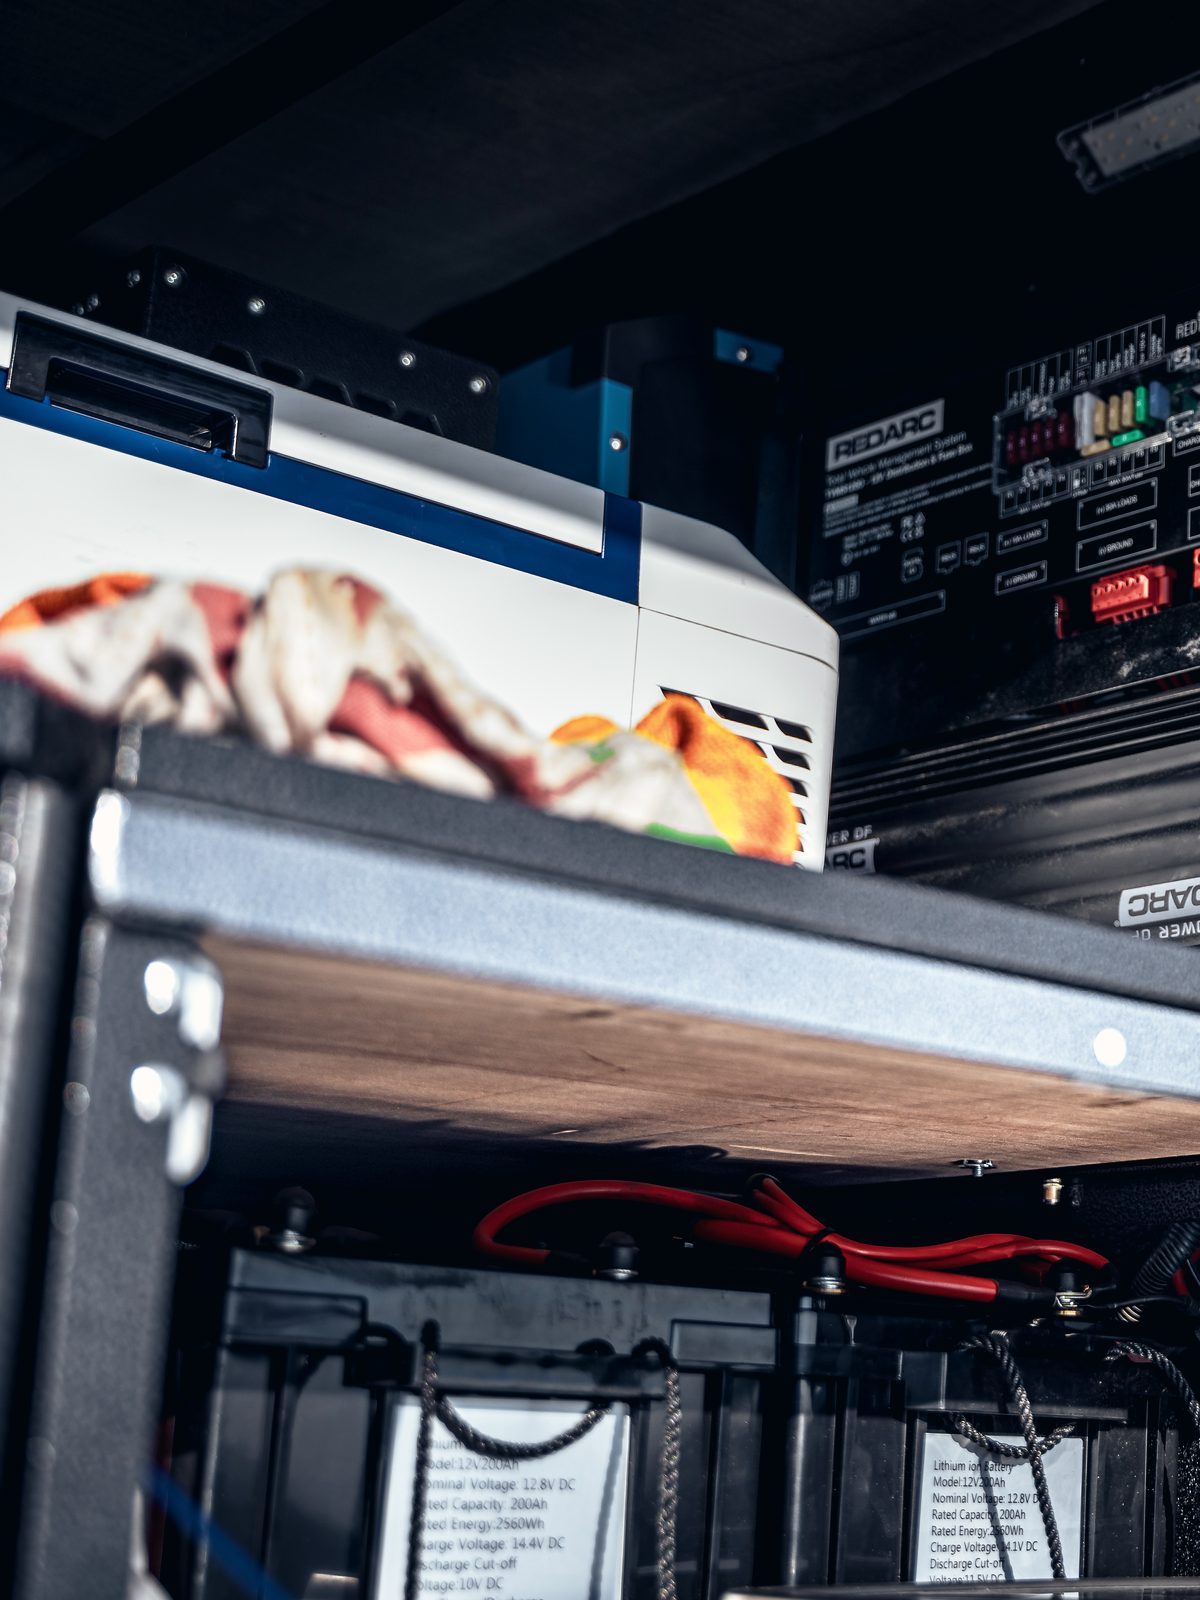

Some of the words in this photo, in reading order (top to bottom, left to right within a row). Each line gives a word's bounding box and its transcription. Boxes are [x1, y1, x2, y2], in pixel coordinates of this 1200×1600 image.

[835, 409, 936, 461] REDARC
[1106, 538, 1133, 553] GROUND
[427, 1458, 520, 1471] odel:12V200Ah
[933, 1459, 966, 1471] Lithium
[968, 1460, 982, 1472] ion
[984, 1461, 1013, 1475] Battery
[427, 1477, 466, 1490] ominal
[523, 1477, 556, 1490] 12.8V
[559, 1477, 576, 1490] DC
[933, 1476, 1006, 1487] Model:12V200Ah
[510, 1497, 548, 1511] 200Ah
[932, 1492, 969, 1504] Nominal
[971, 1492, 1006, 1507] Voltage:
[1007, 1492, 1031, 1504] 12.8V
[932, 1509, 957, 1520] Rated
[999, 1508, 1026, 1520] 200Ah
[931, 1525, 956, 1536] Rated
[512, 1536, 545, 1550] 14.4V
[548, 1536, 566, 1549] DC
[930, 1541, 961, 1555] Charge
[963, 1541, 998, 1555] Voltage:
[1000, 1540, 1024, 1552] 14.1V
[1025, 1540, 1038, 1551] DC
[474, 1556, 517, 1570] Cut-off
[930, 1558, 973, 1571] Discharge
[974, 1557, 1005, 1569] Cut-off
[418, 1577, 482, 1593] oltage:10V
[486, 1577, 504, 1590] DC
